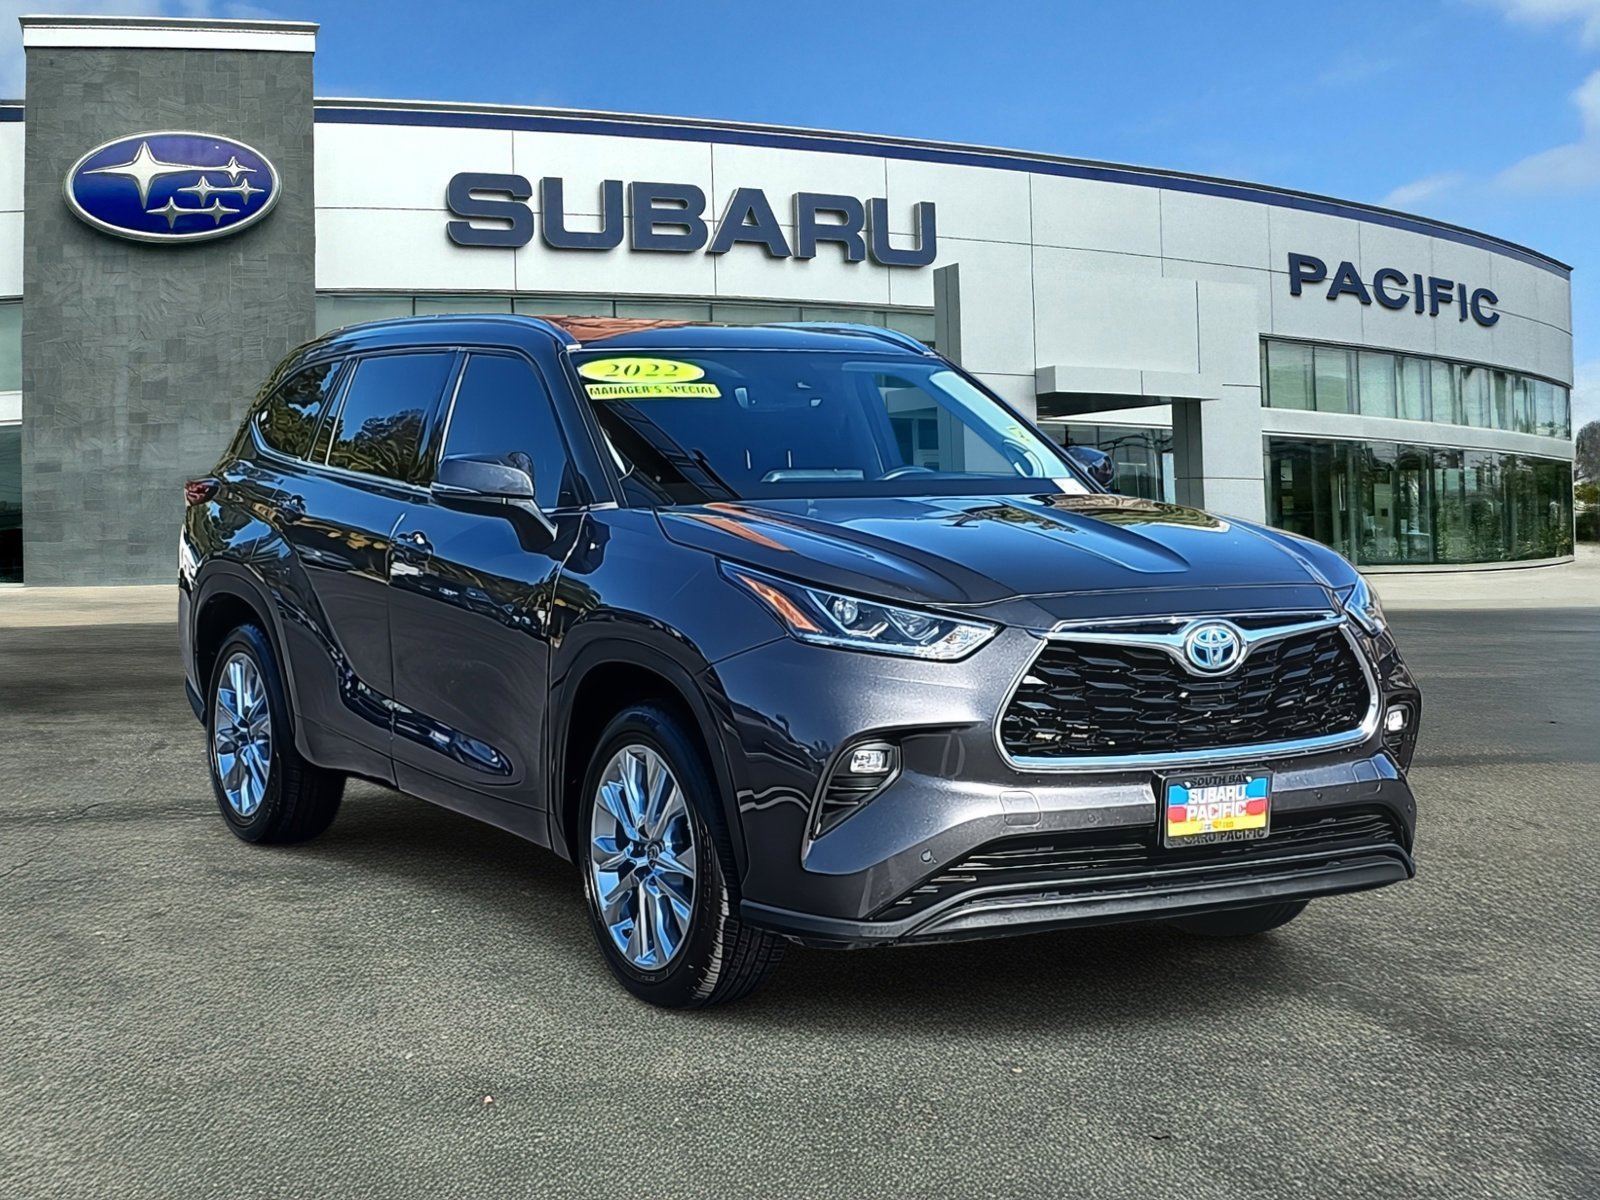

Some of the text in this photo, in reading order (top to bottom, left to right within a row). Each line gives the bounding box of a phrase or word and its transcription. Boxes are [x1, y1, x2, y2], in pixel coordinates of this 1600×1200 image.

[446, 171, 937, 268] SUBARU
[1287, 251, 1501, 327] PACIFIC
[603, 362, 679, 377] 2022
[588, 384, 717, 397] MANAGER'S SPECIAL
[1190, 776, 1226, 788] SOUTH
[1189, 784, 1247, 805] SUBARU
[1187, 801, 1247, 822] PACIFIC
[1220, 829, 1265, 842] PACIFIC
